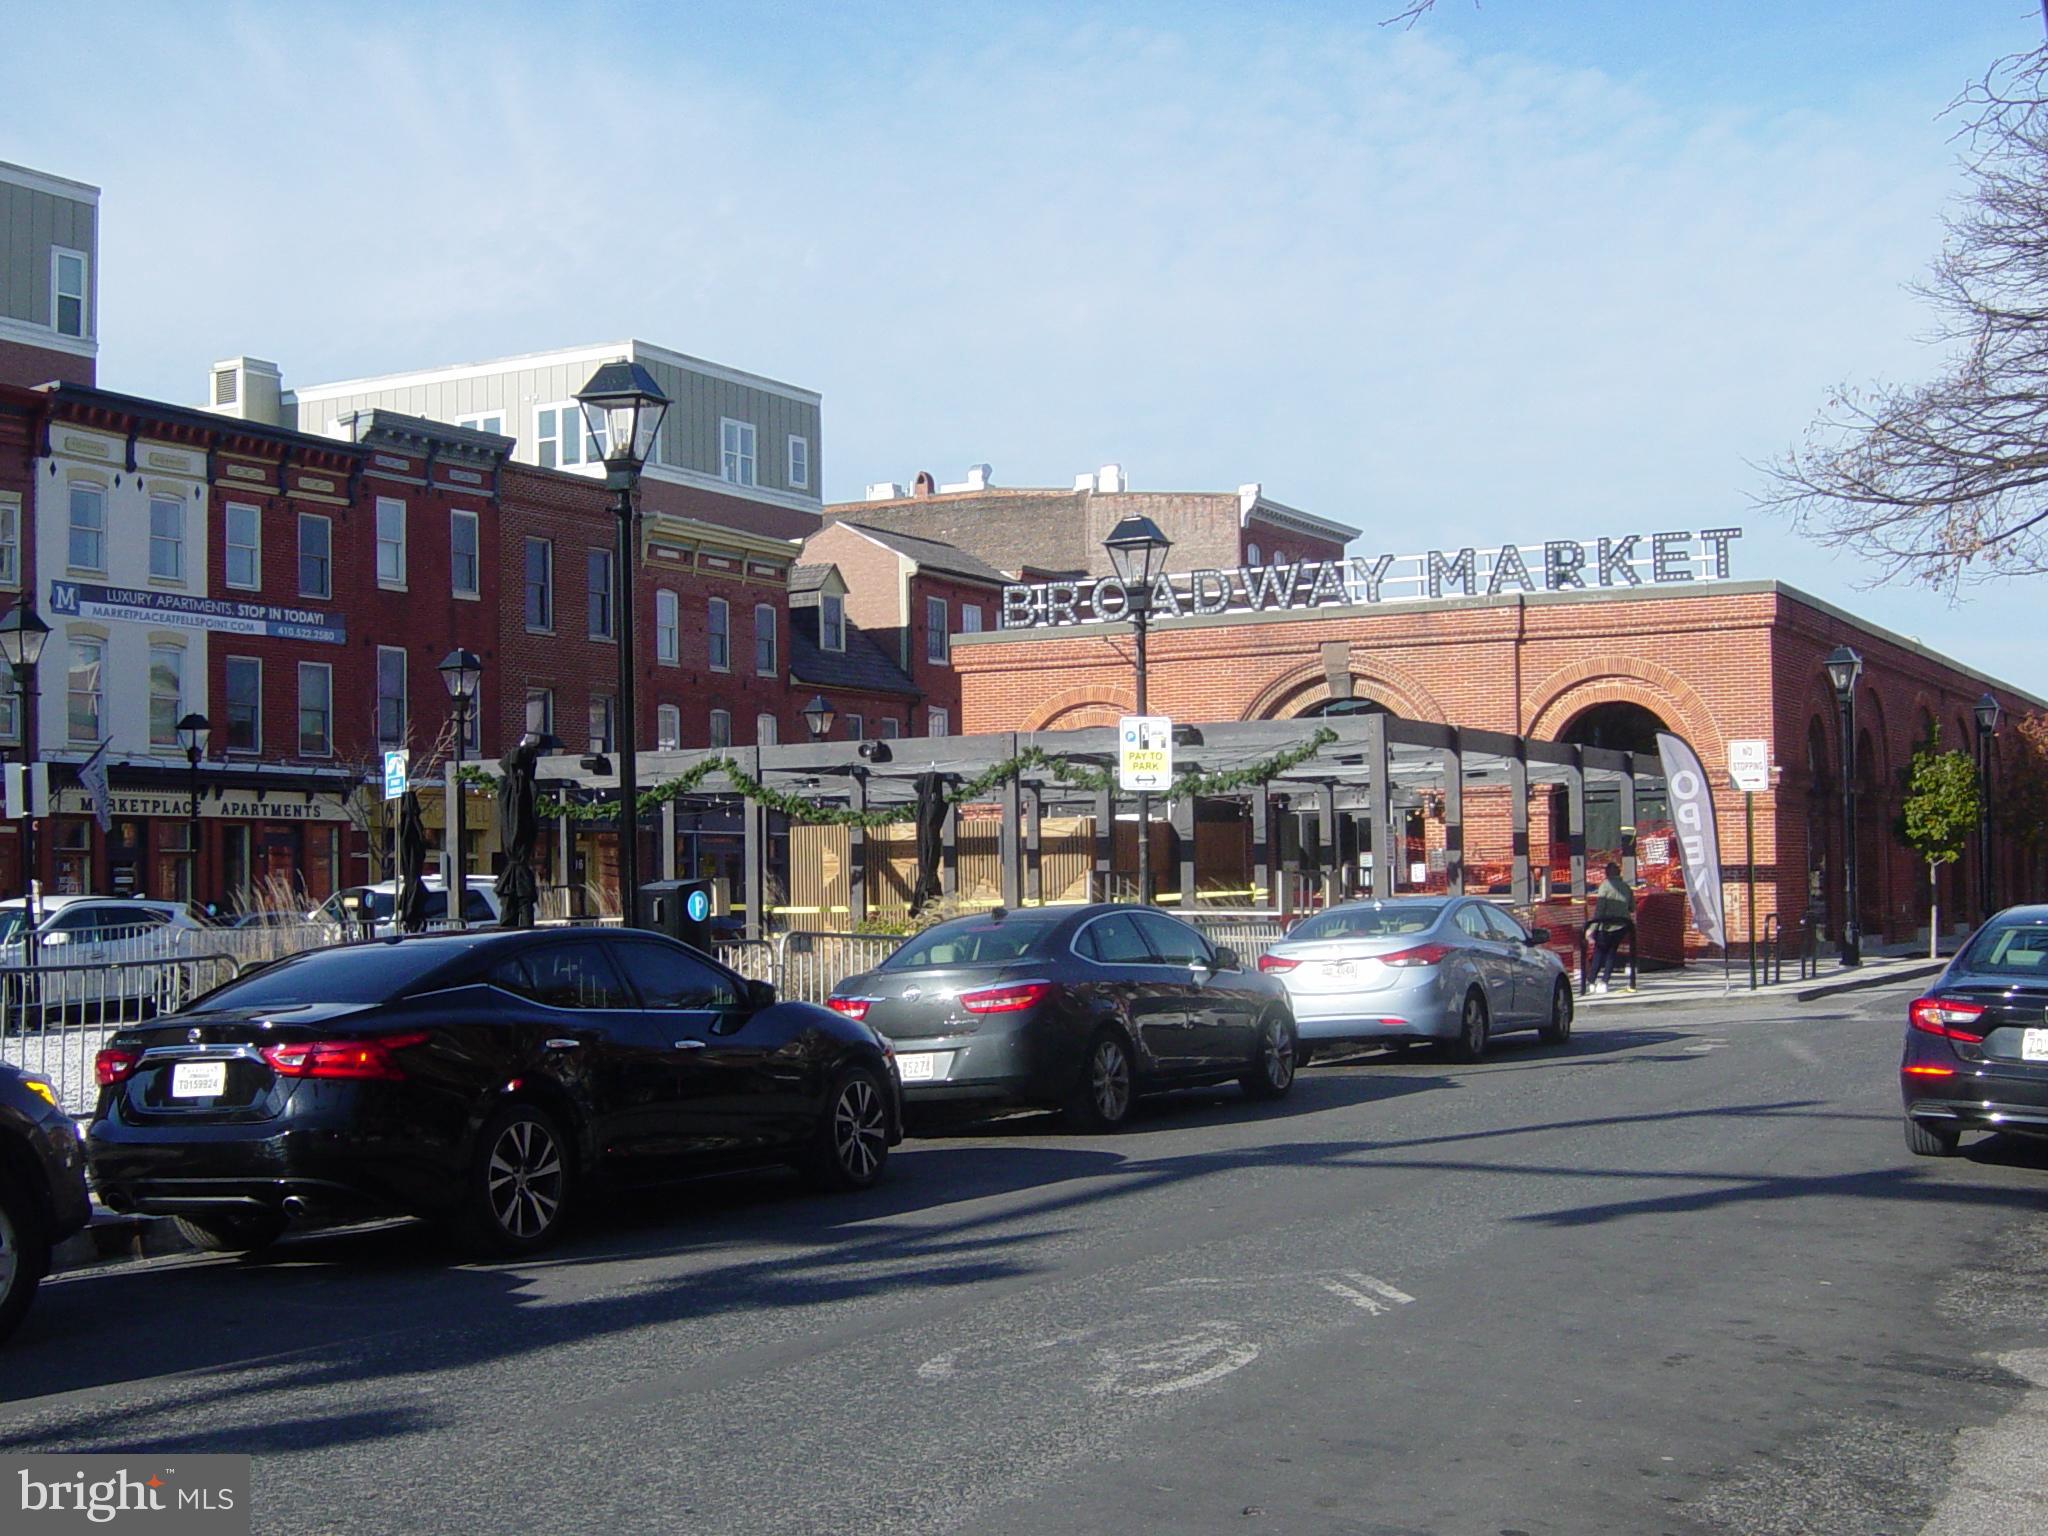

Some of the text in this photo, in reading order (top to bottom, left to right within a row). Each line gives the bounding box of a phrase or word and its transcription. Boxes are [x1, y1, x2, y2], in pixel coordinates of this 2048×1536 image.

[1000, 527, 1743, 629] BROADWAY MARKET
[56, 585, 77, 611] M
[106, 589, 153, 606] LUXURY
[238, 604, 266, 619] STOP
[269, 607, 281, 621] IN
[284, 609, 324, 626] TODAY!
[92, 606, 255, 633] MARKETPLACEATFELLSPOINT.COM
[1128, 751, 1163, 761] PAY TO
[1132, 762, 1159, 771] PARK
[80, 796, 321, 818] MRKETPLACE APARTMENTS
